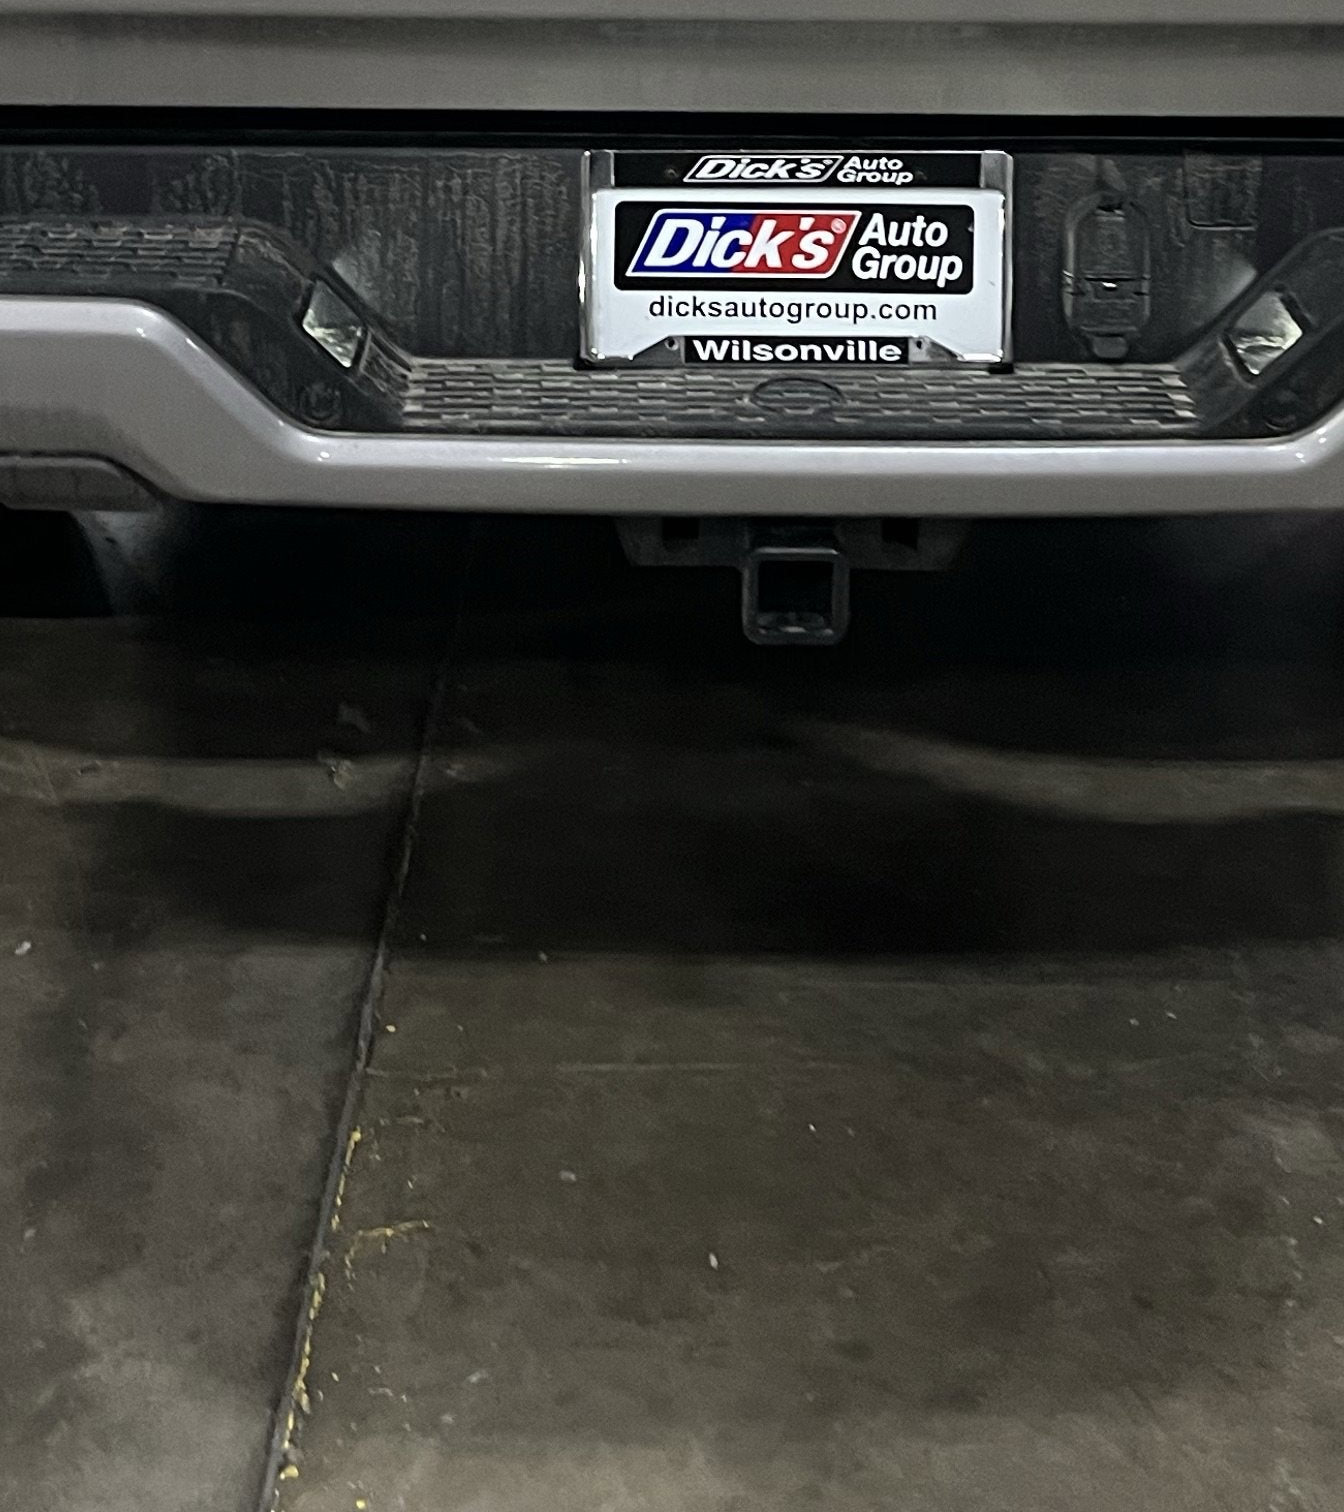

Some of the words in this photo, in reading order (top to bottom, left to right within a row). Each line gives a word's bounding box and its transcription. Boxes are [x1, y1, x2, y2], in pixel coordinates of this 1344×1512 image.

[695, 157, 827, 180] Dick's
[837, 168, 914, 185] Group
[843, 156, 903, 170] Auto
[643, 216, 838, 270] Dick's
[858, 213, 948, 247] Auto
[851, 247, 964, 288] Group
[649, 296, 937, 325] dicksautogroup.com
[692, 338, 903, 363] Wilsonville
